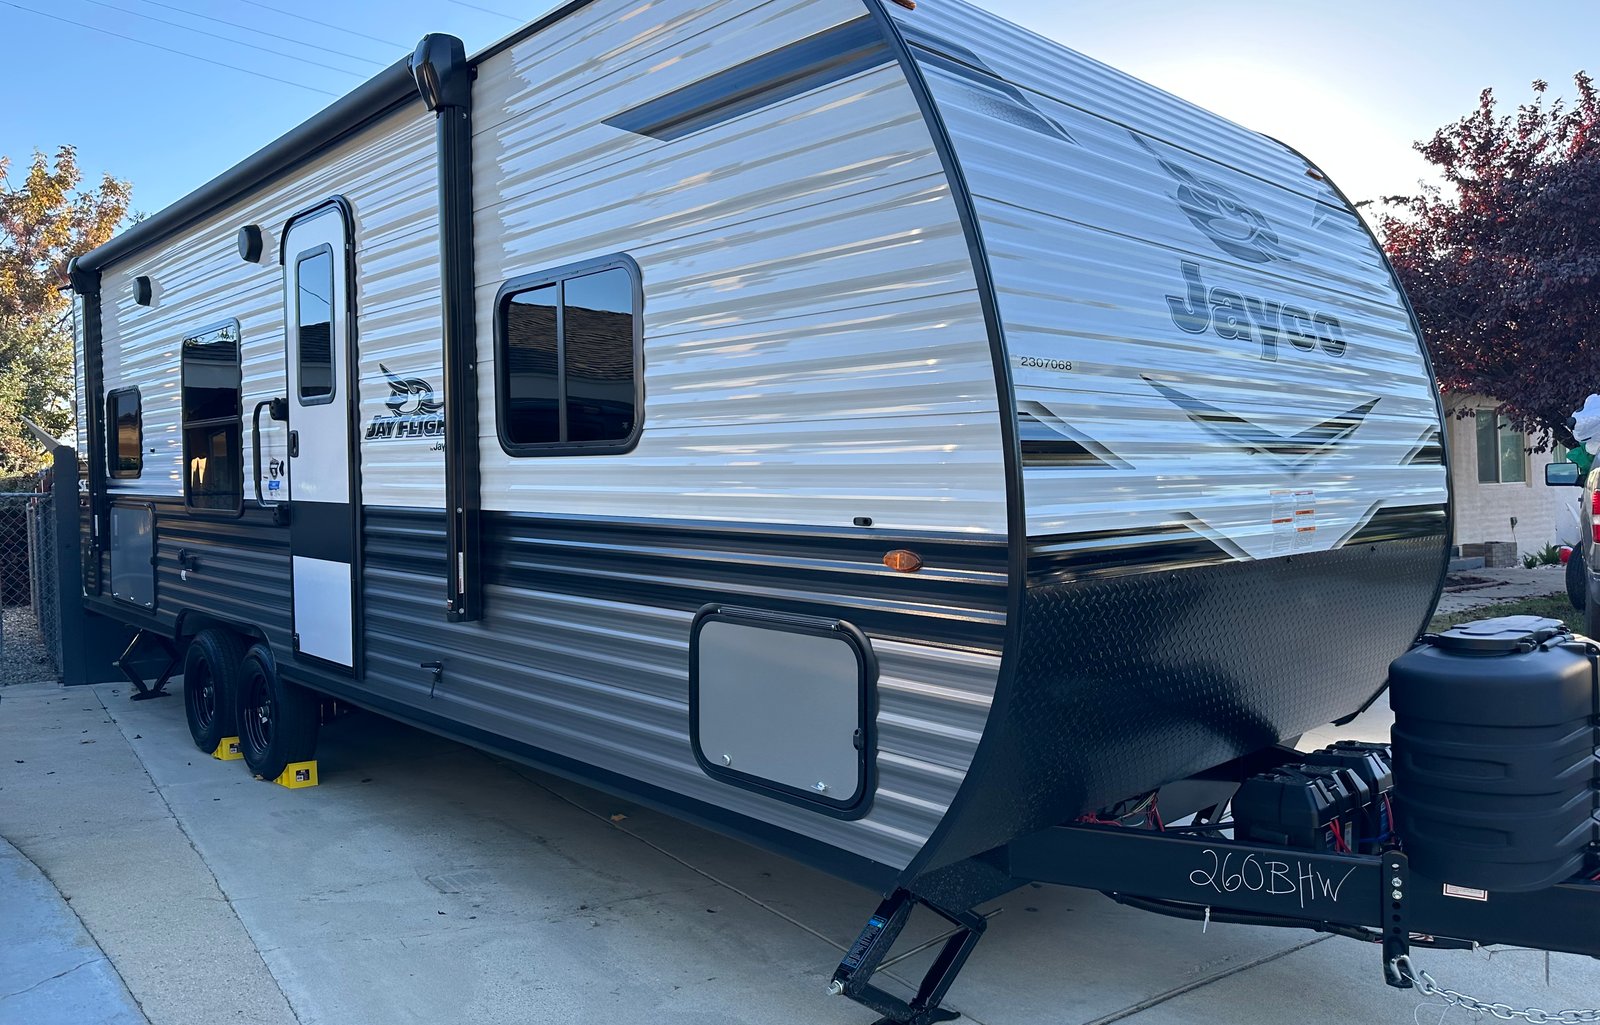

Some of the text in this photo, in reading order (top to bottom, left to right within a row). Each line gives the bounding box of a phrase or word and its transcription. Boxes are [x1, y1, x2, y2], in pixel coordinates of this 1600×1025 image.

[1165, 259, 1348, 362] Jayco
[1021, 356, 1072, 371] 2307068
[365, 415, 445, 440] JAY FLIGH
[433, 441, 445, 452] Jay
[1189, 849, 1357, 909] 260BHW
